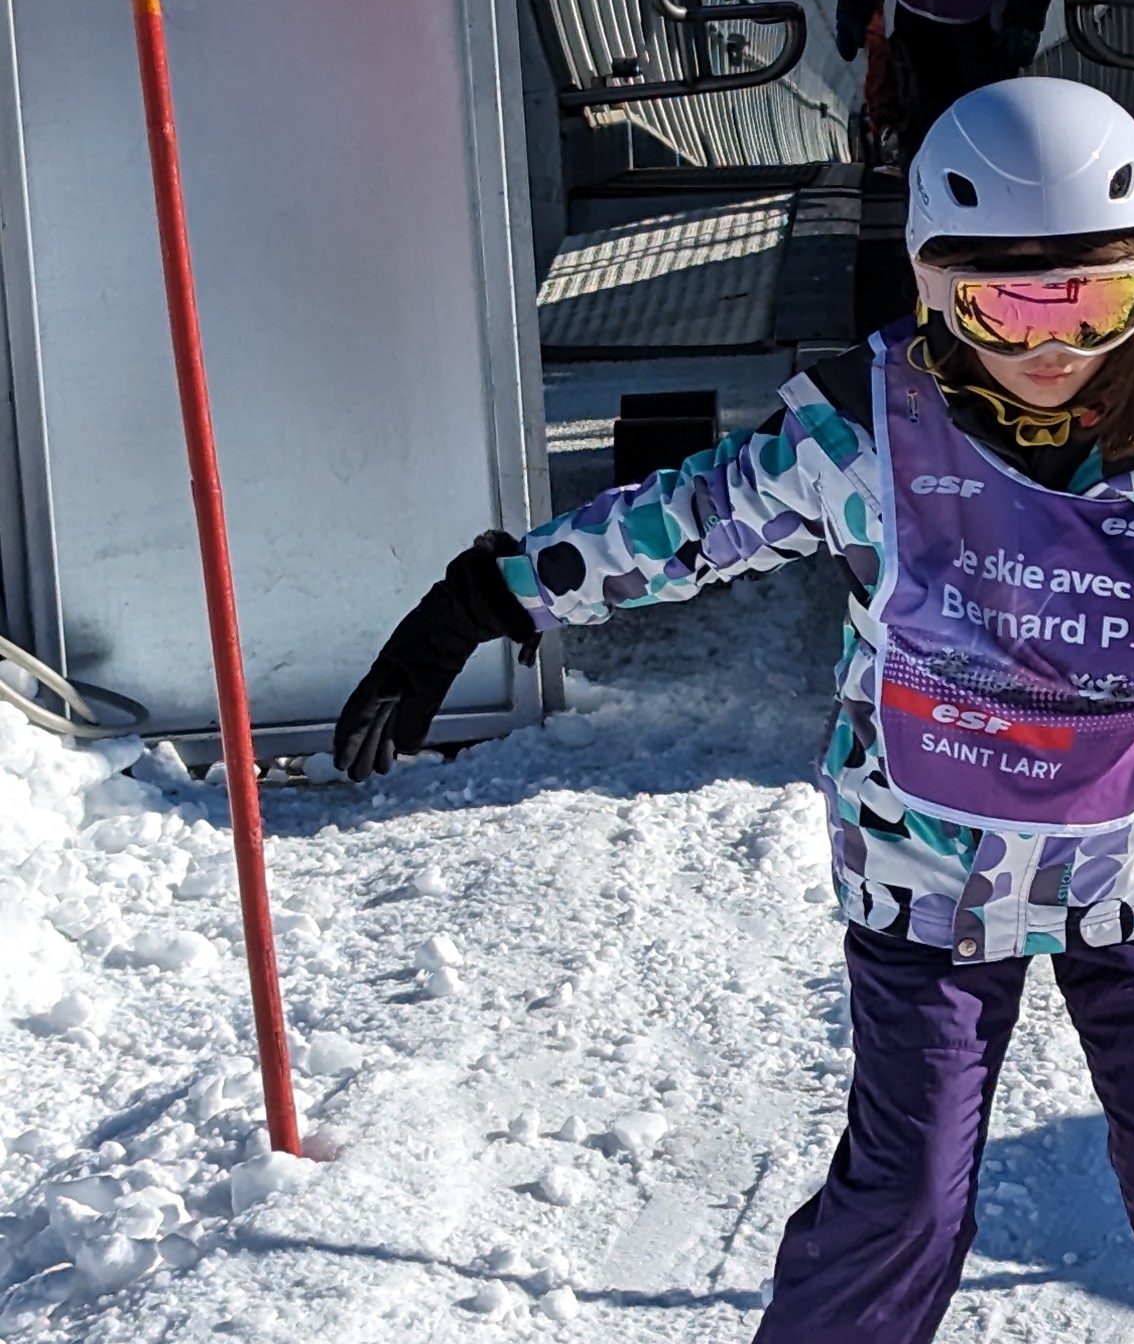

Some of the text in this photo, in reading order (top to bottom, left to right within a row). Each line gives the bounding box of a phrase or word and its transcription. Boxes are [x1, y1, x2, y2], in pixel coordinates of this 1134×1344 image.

[952, 538, 1132, 599] Je skie avec
[941, 584, 1086, 645] Bernard
[921, 734, 1063, 780] SAINT LARY
